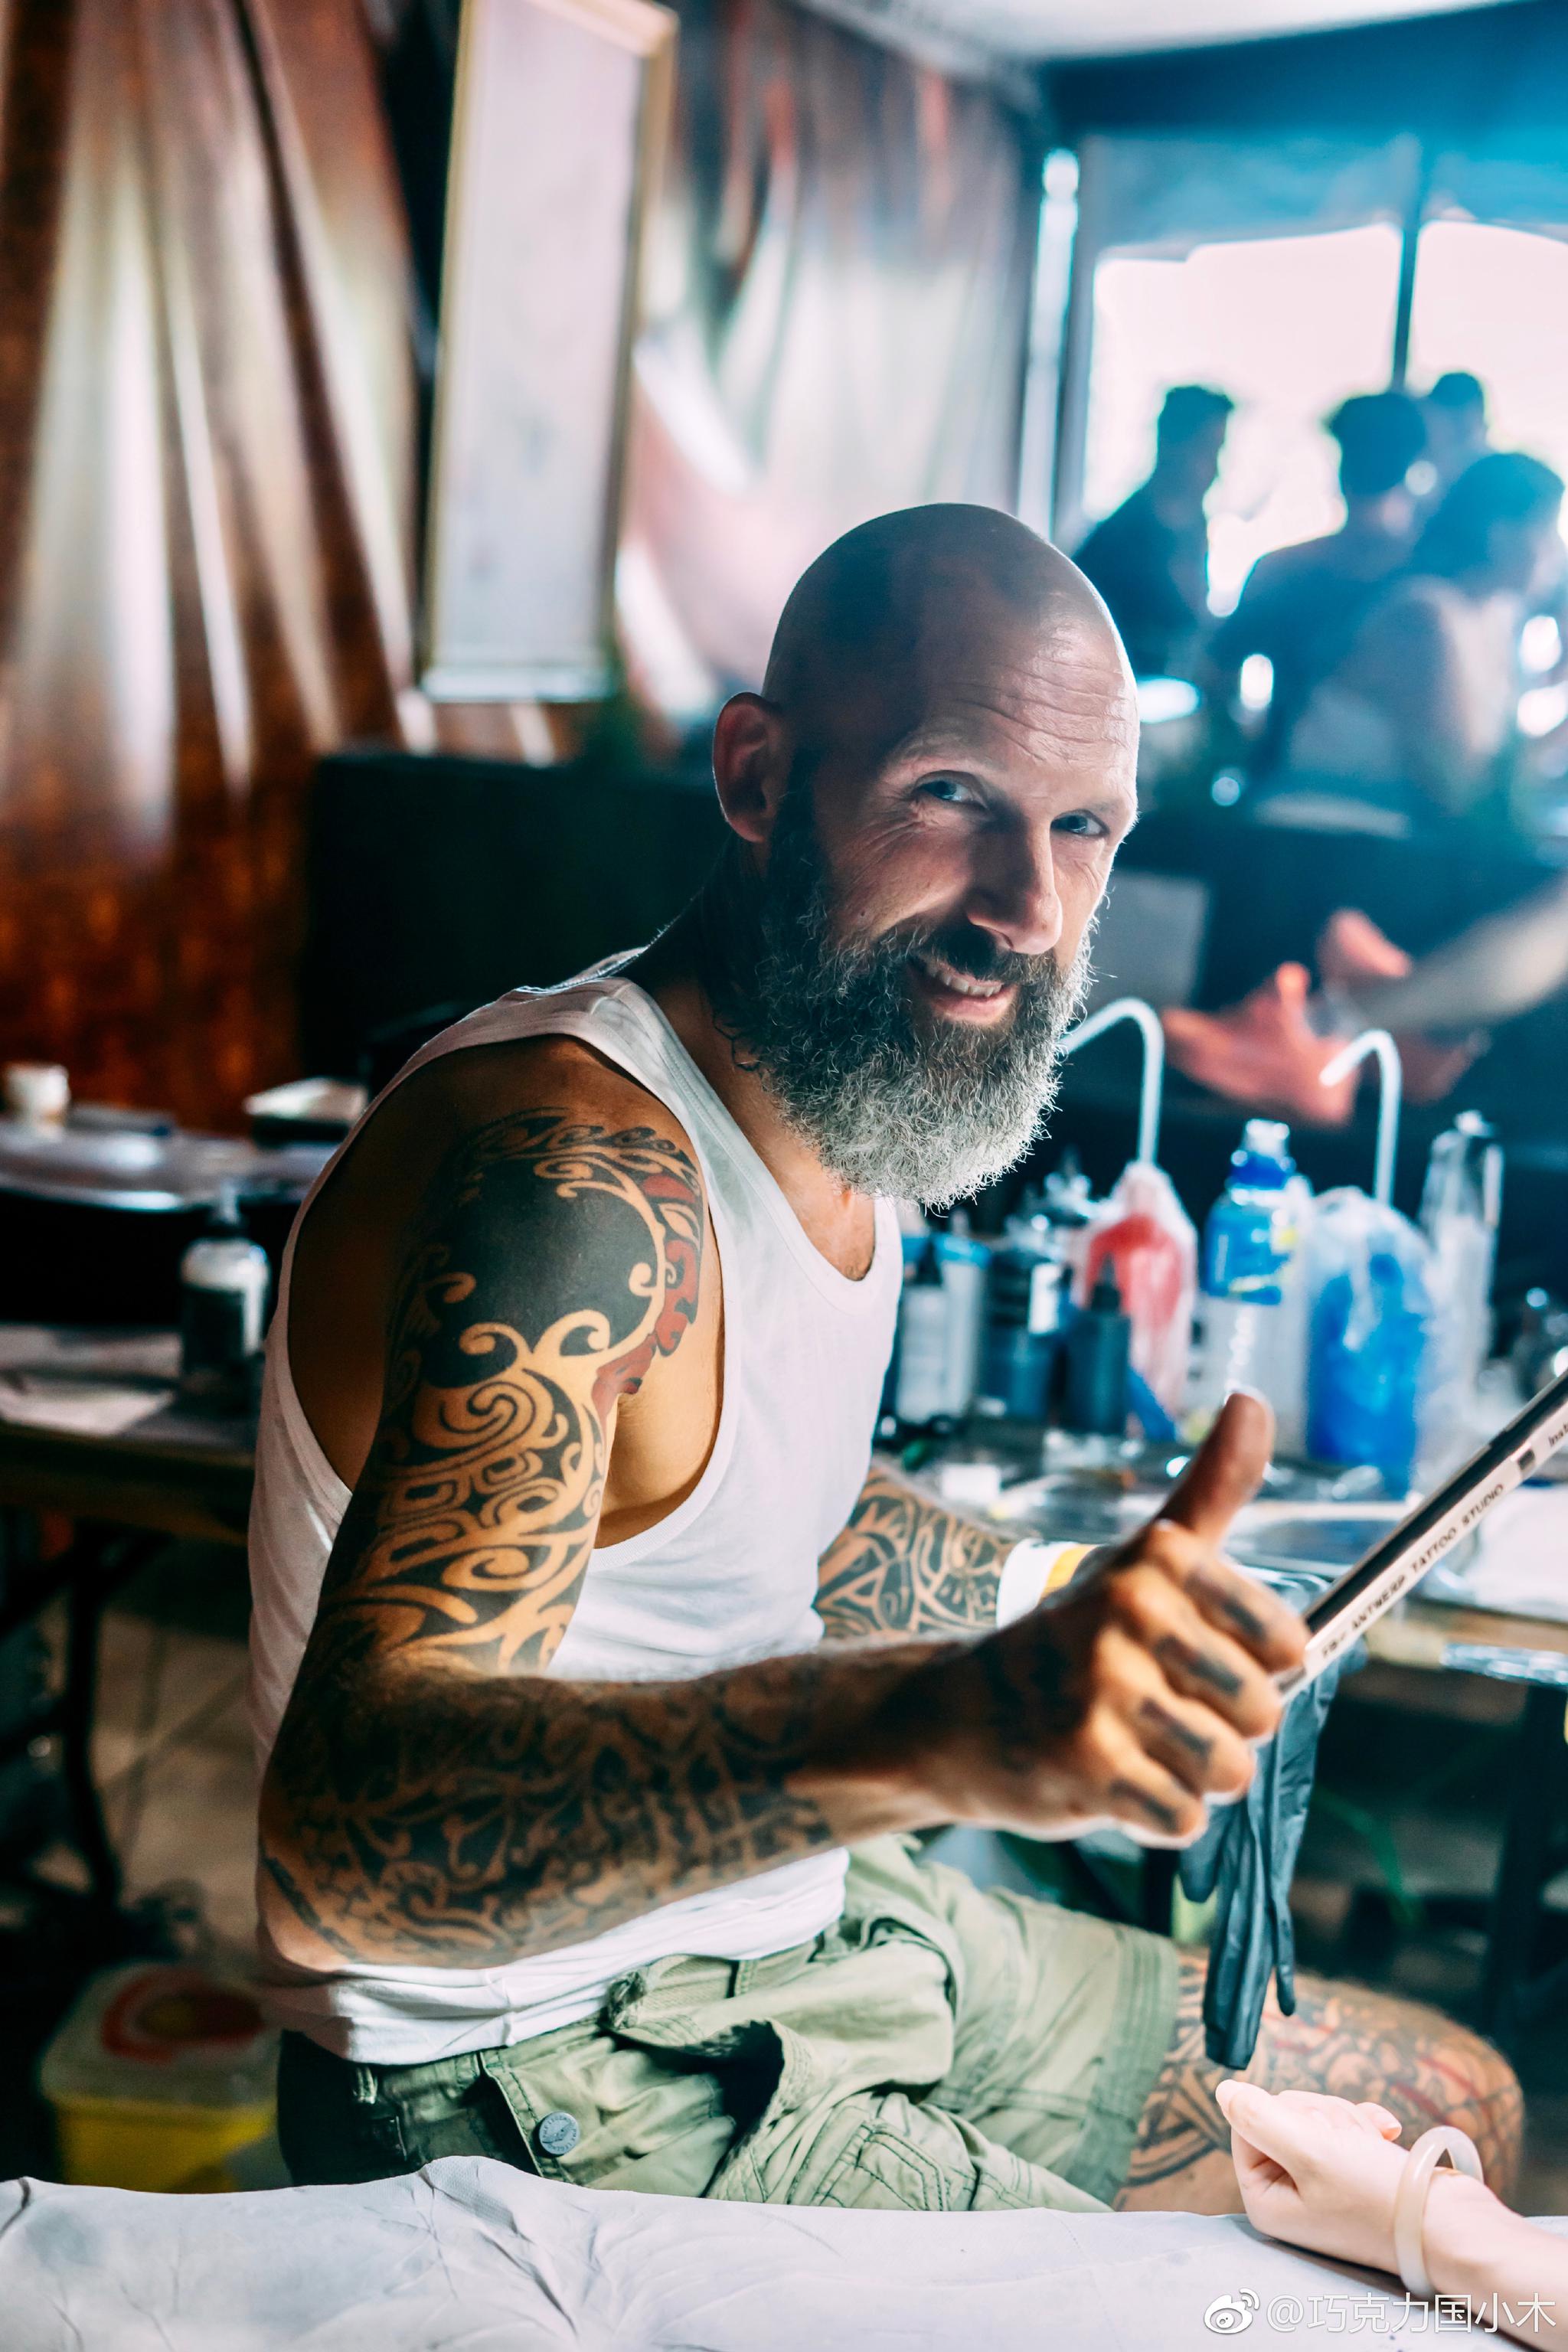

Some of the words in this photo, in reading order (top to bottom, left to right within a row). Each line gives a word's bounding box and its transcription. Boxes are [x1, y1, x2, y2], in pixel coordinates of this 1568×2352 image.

[1352, 1575, 1404, 1630] ANTWERP
[1412, 1527, 1456, 1571] TATTOO
[1462, 1484, 1503, 1526] STUDIO
